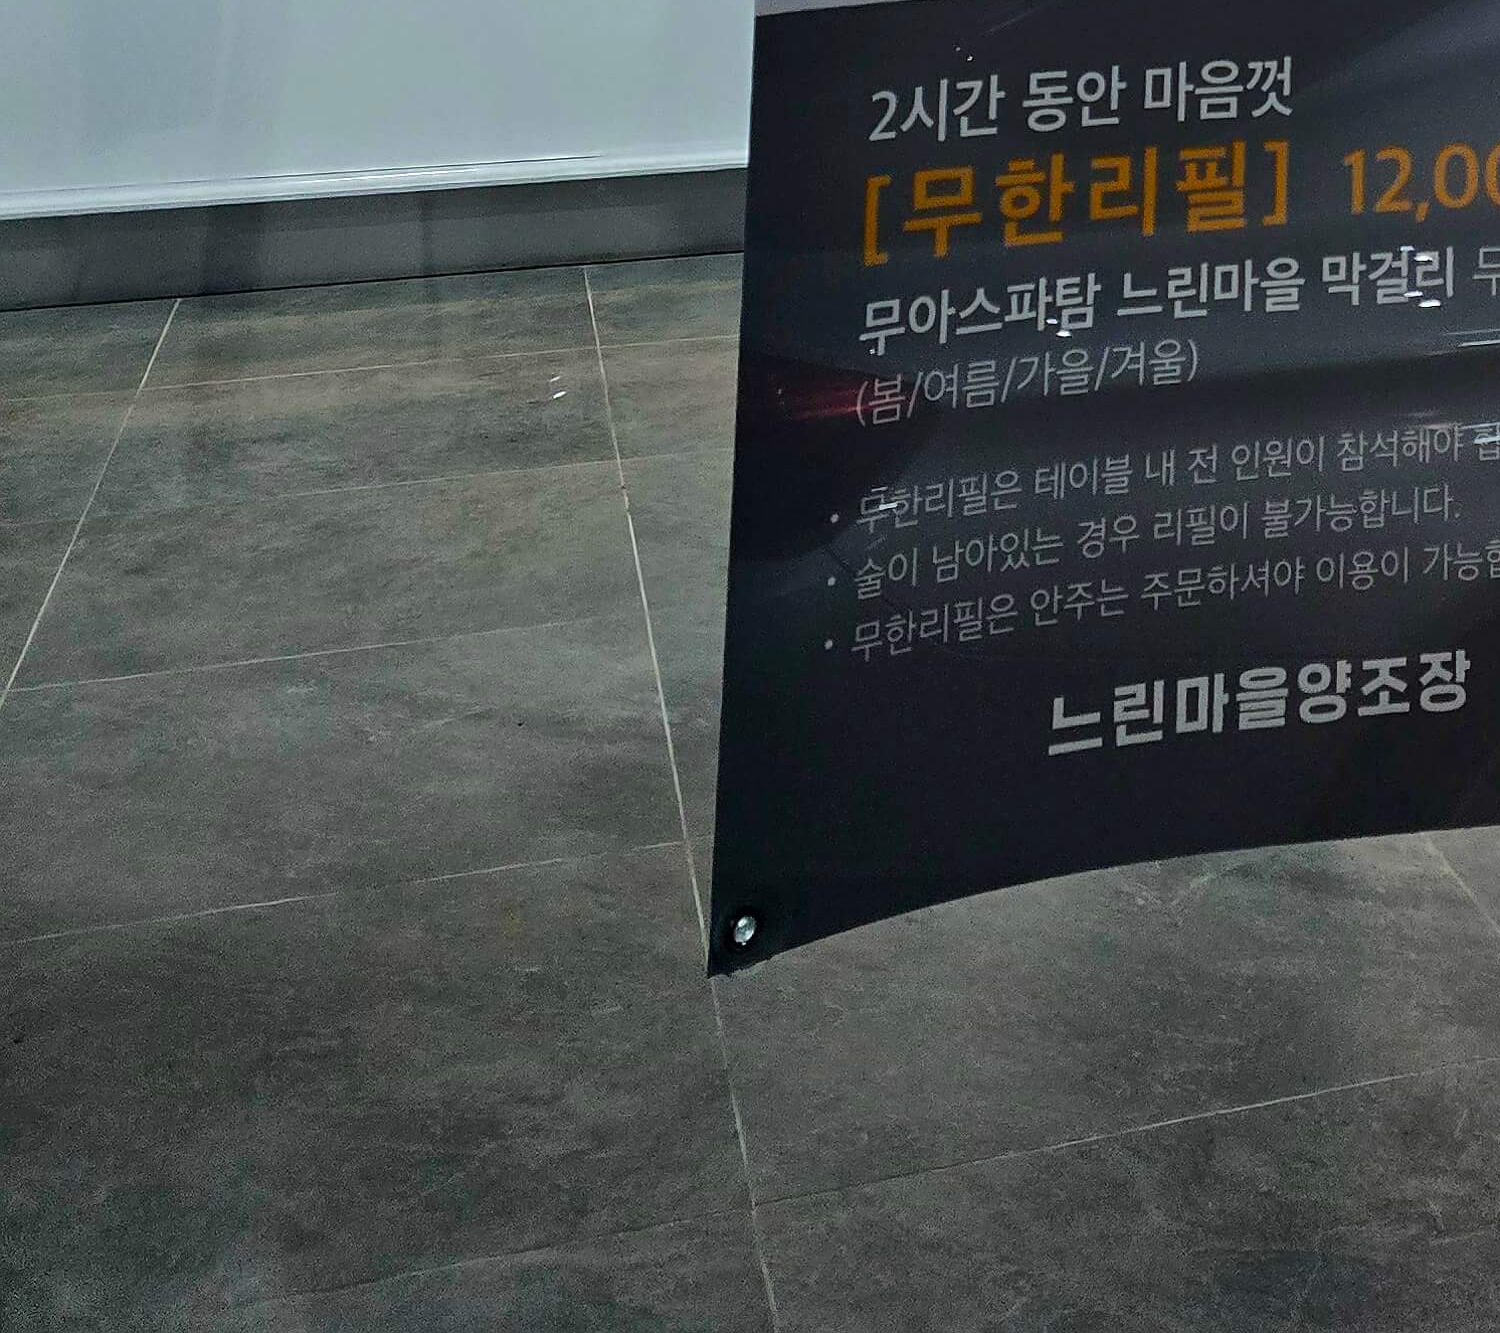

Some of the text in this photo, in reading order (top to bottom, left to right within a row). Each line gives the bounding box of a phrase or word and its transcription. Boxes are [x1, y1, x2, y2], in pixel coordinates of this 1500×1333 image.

[868, 56, 1294, 142] 2시간 동안 마음껏
[858, 272, 1102, 356] 무아스파탐
[1117, 256, 1306, 318] 느린마을
[1322, 245, 1455, 308] 막걸리
[855, 338, 1200, 428] (봄/여름/가을/겨울)
[1034, 454, 1134, 501] 테이블
[1145, 448, 1177, 487] 내
[1187, 444, 1219, 485] 전
[1231, 436, 1327, 481] 인원이
[1336, 423, 1463, 473] 참석해야
[853, 484, 1461, 601] 술이 남아있는 경우 리필이 불가능합니다.
[850, 592, 1019, 662] 무한리필은
[1030, 578, 1130, 627] 안주는
[1141, 558, 1306, 611] 주문하셔야
[1316, 546, 1410, 592] 이용이
[1048, 649, 1472, 757] 느린마을양조장
